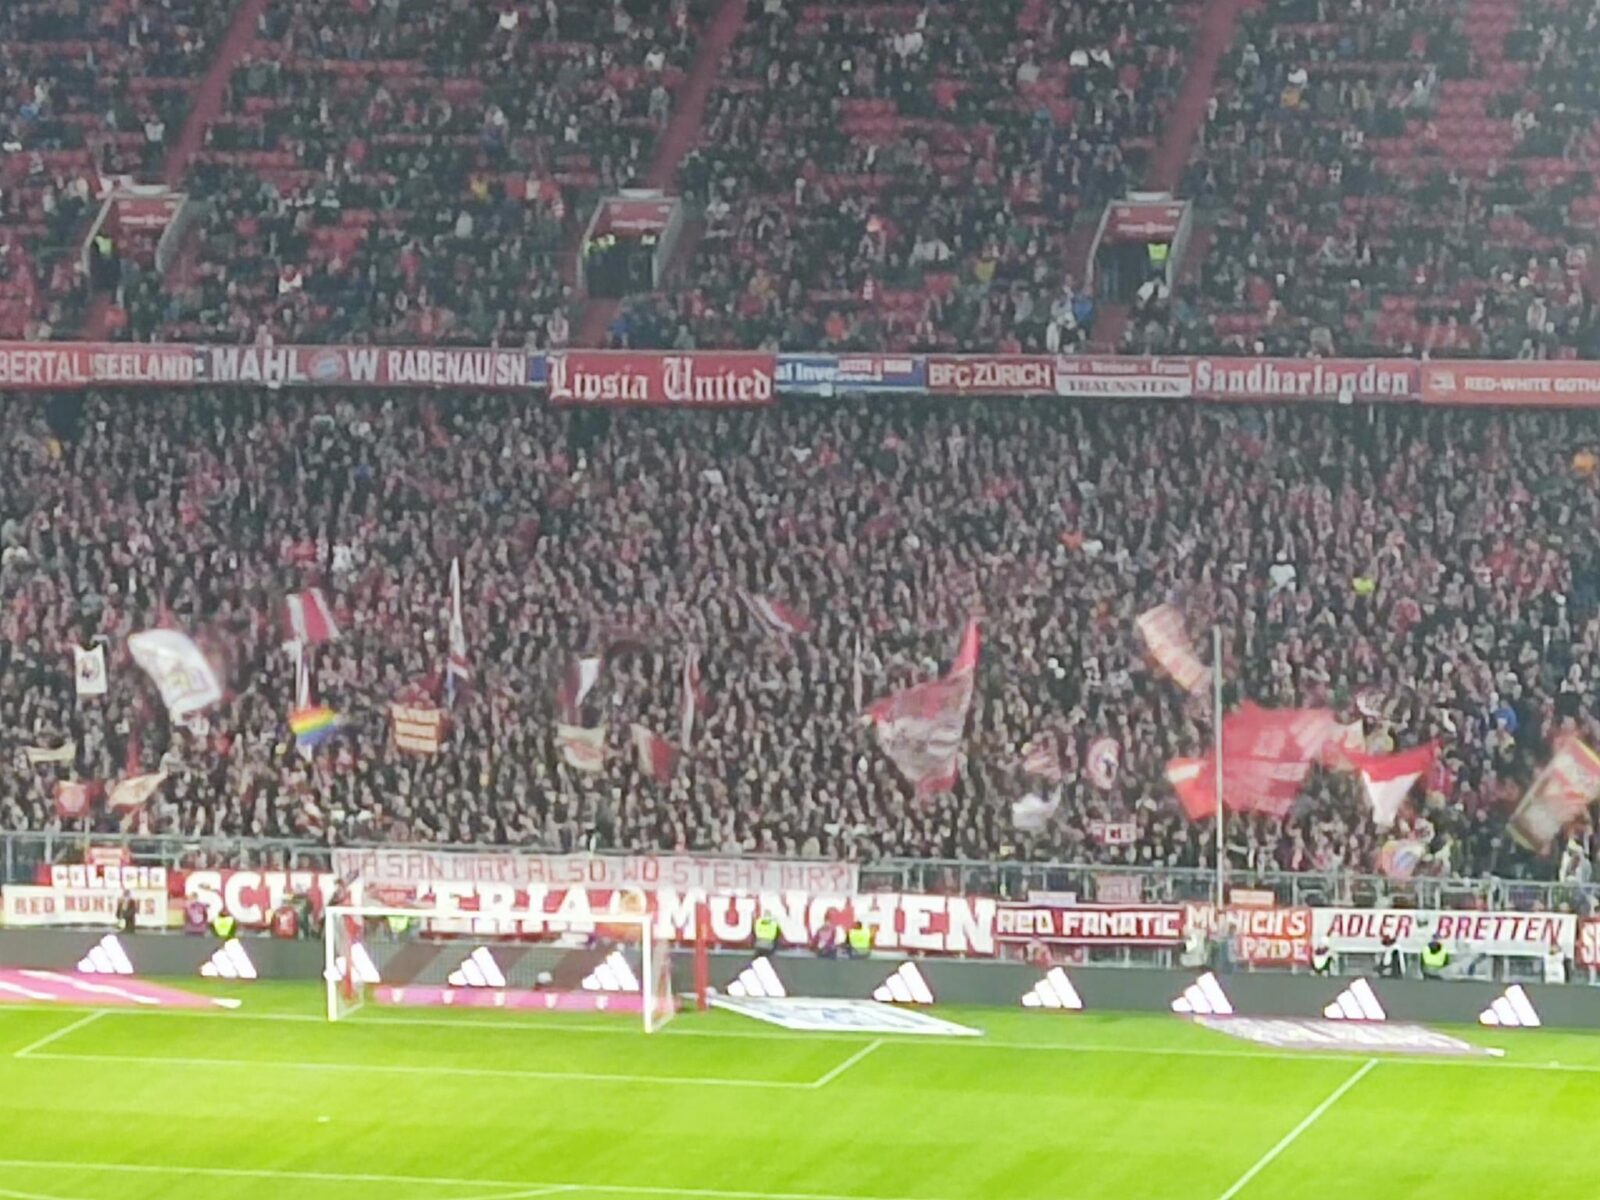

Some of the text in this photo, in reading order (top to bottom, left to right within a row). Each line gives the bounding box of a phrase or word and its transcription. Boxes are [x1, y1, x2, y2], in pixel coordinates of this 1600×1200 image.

[213, 347, 378, 383] MAHL W
[662, 356, 773, 401] United
[929, 363, 971, 387] BFC
[1196, 360, 1409, 396] Sandharlanden
[386, 853, 444, 879] SAN
[622, 857, 660, 883] WO
[672, 859, 768, 887] STEHT
[14, 896, 56, 914] RED
[997, 908, 1180, 937] RED FANATIC
[1327, 913, 1564, 942] ADLER BRETTEN
[1241, 935, 1308, 961] PRIDE
